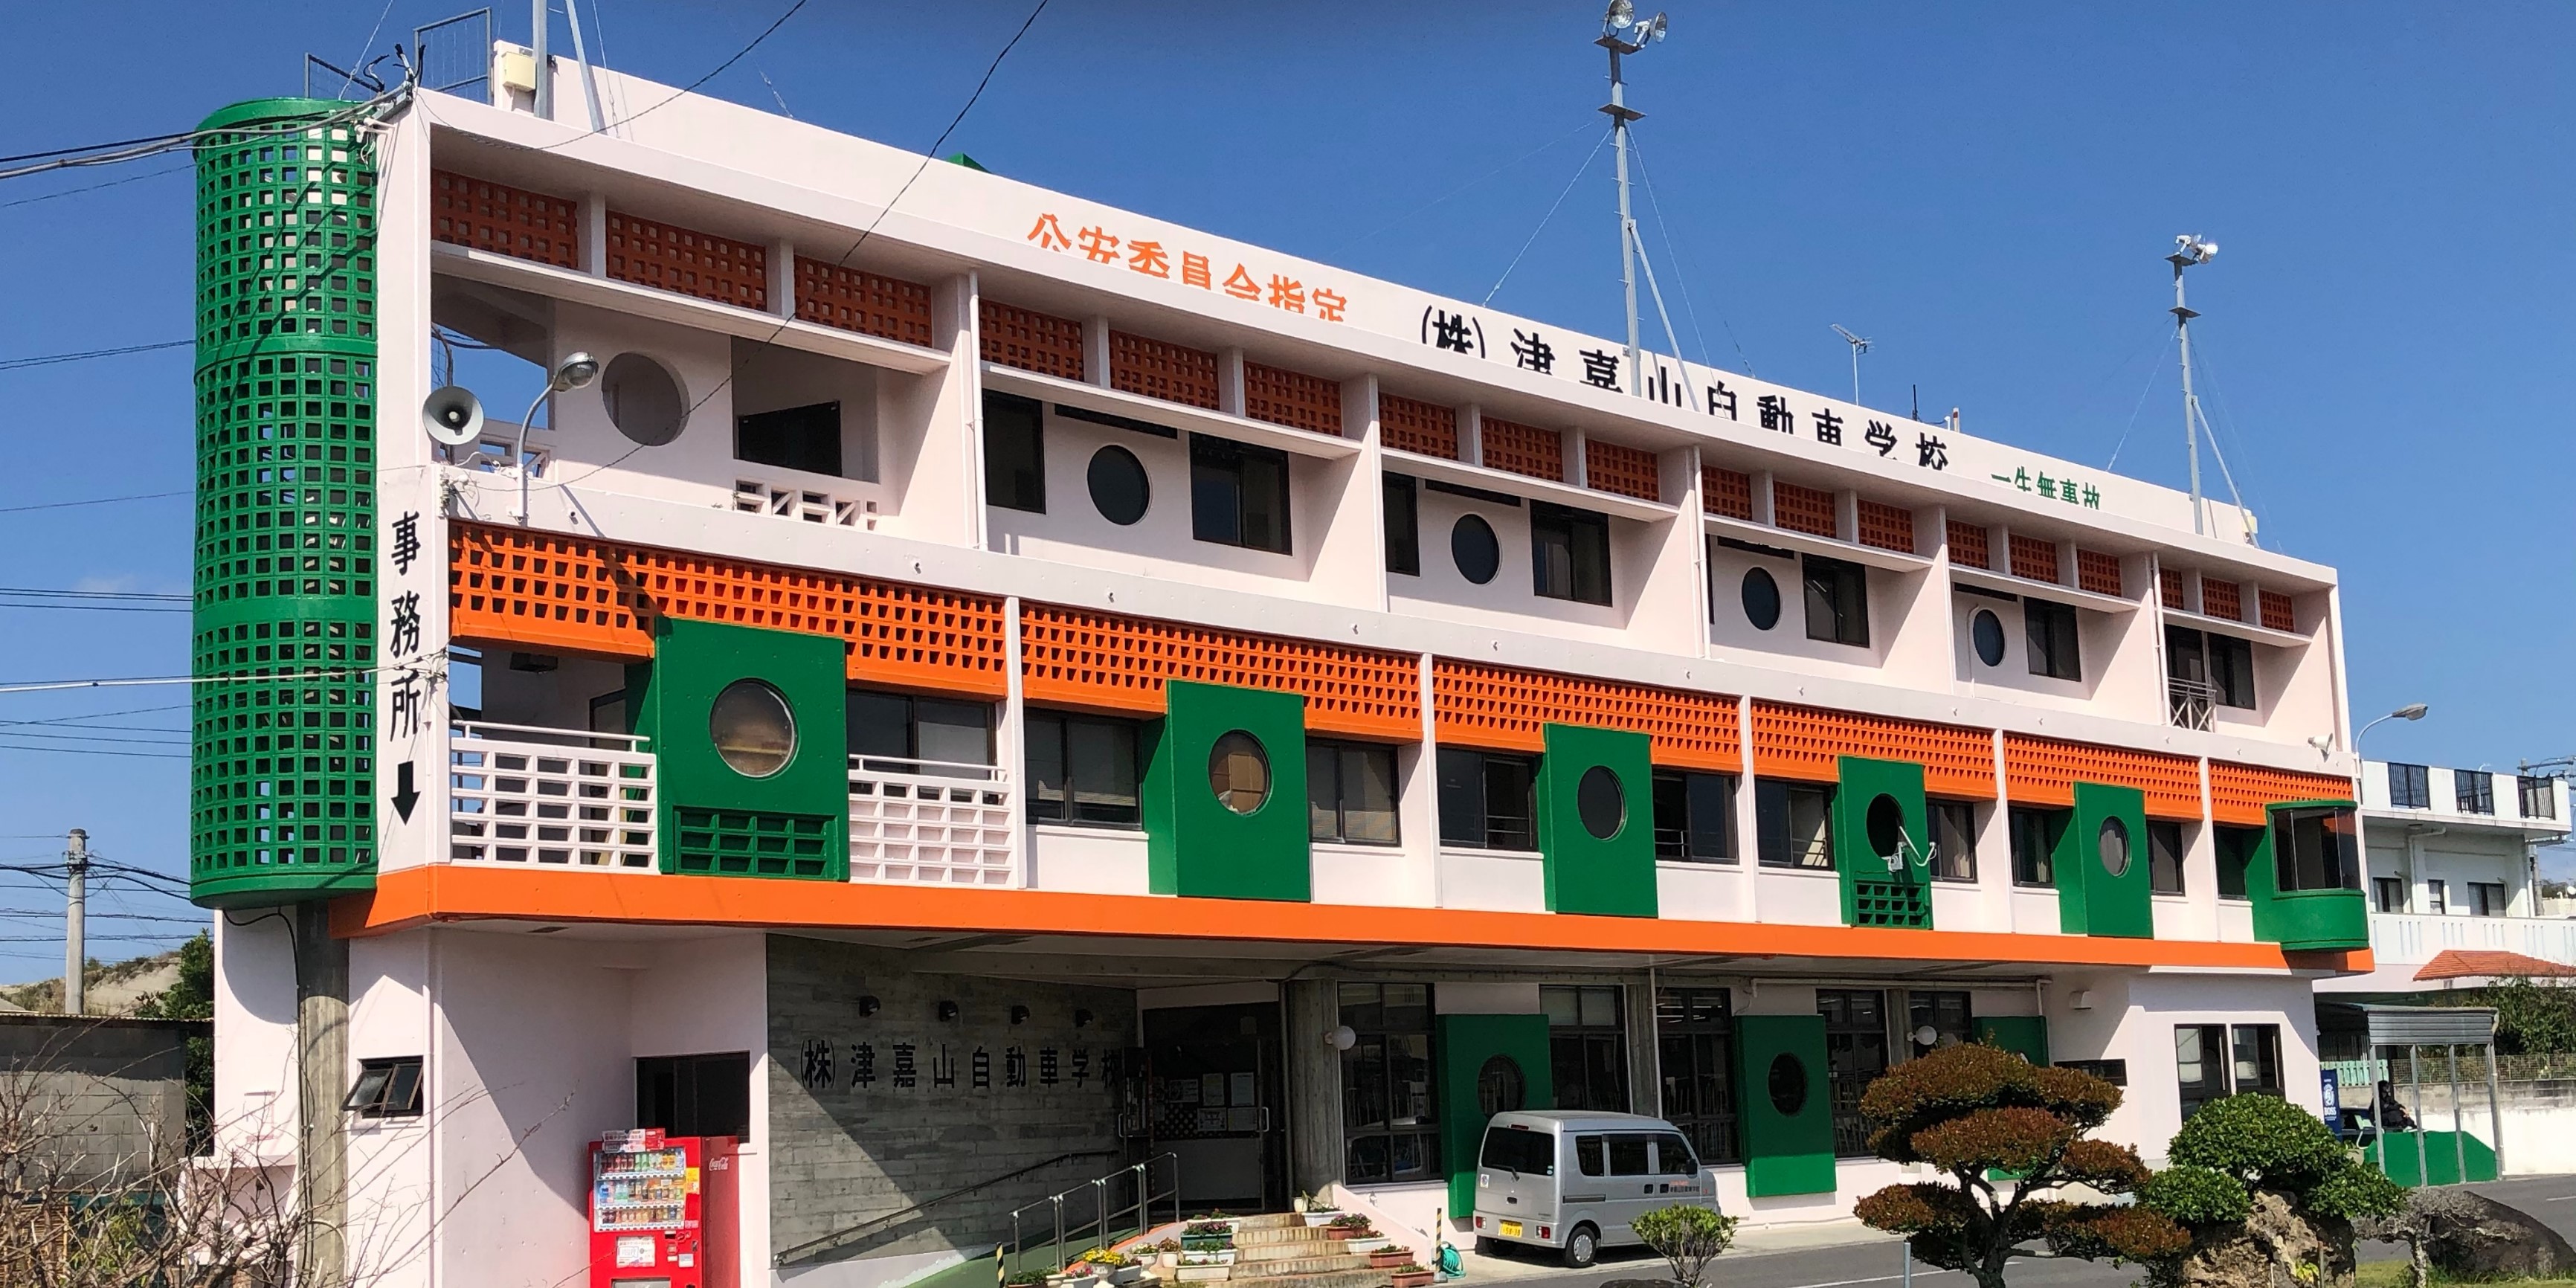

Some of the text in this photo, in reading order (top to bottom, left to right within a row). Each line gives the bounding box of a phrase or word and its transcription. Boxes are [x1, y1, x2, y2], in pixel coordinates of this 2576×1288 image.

[1991, 466, 2101, 510] 一生無事故
[389, 510, 422, 742] 事務所
